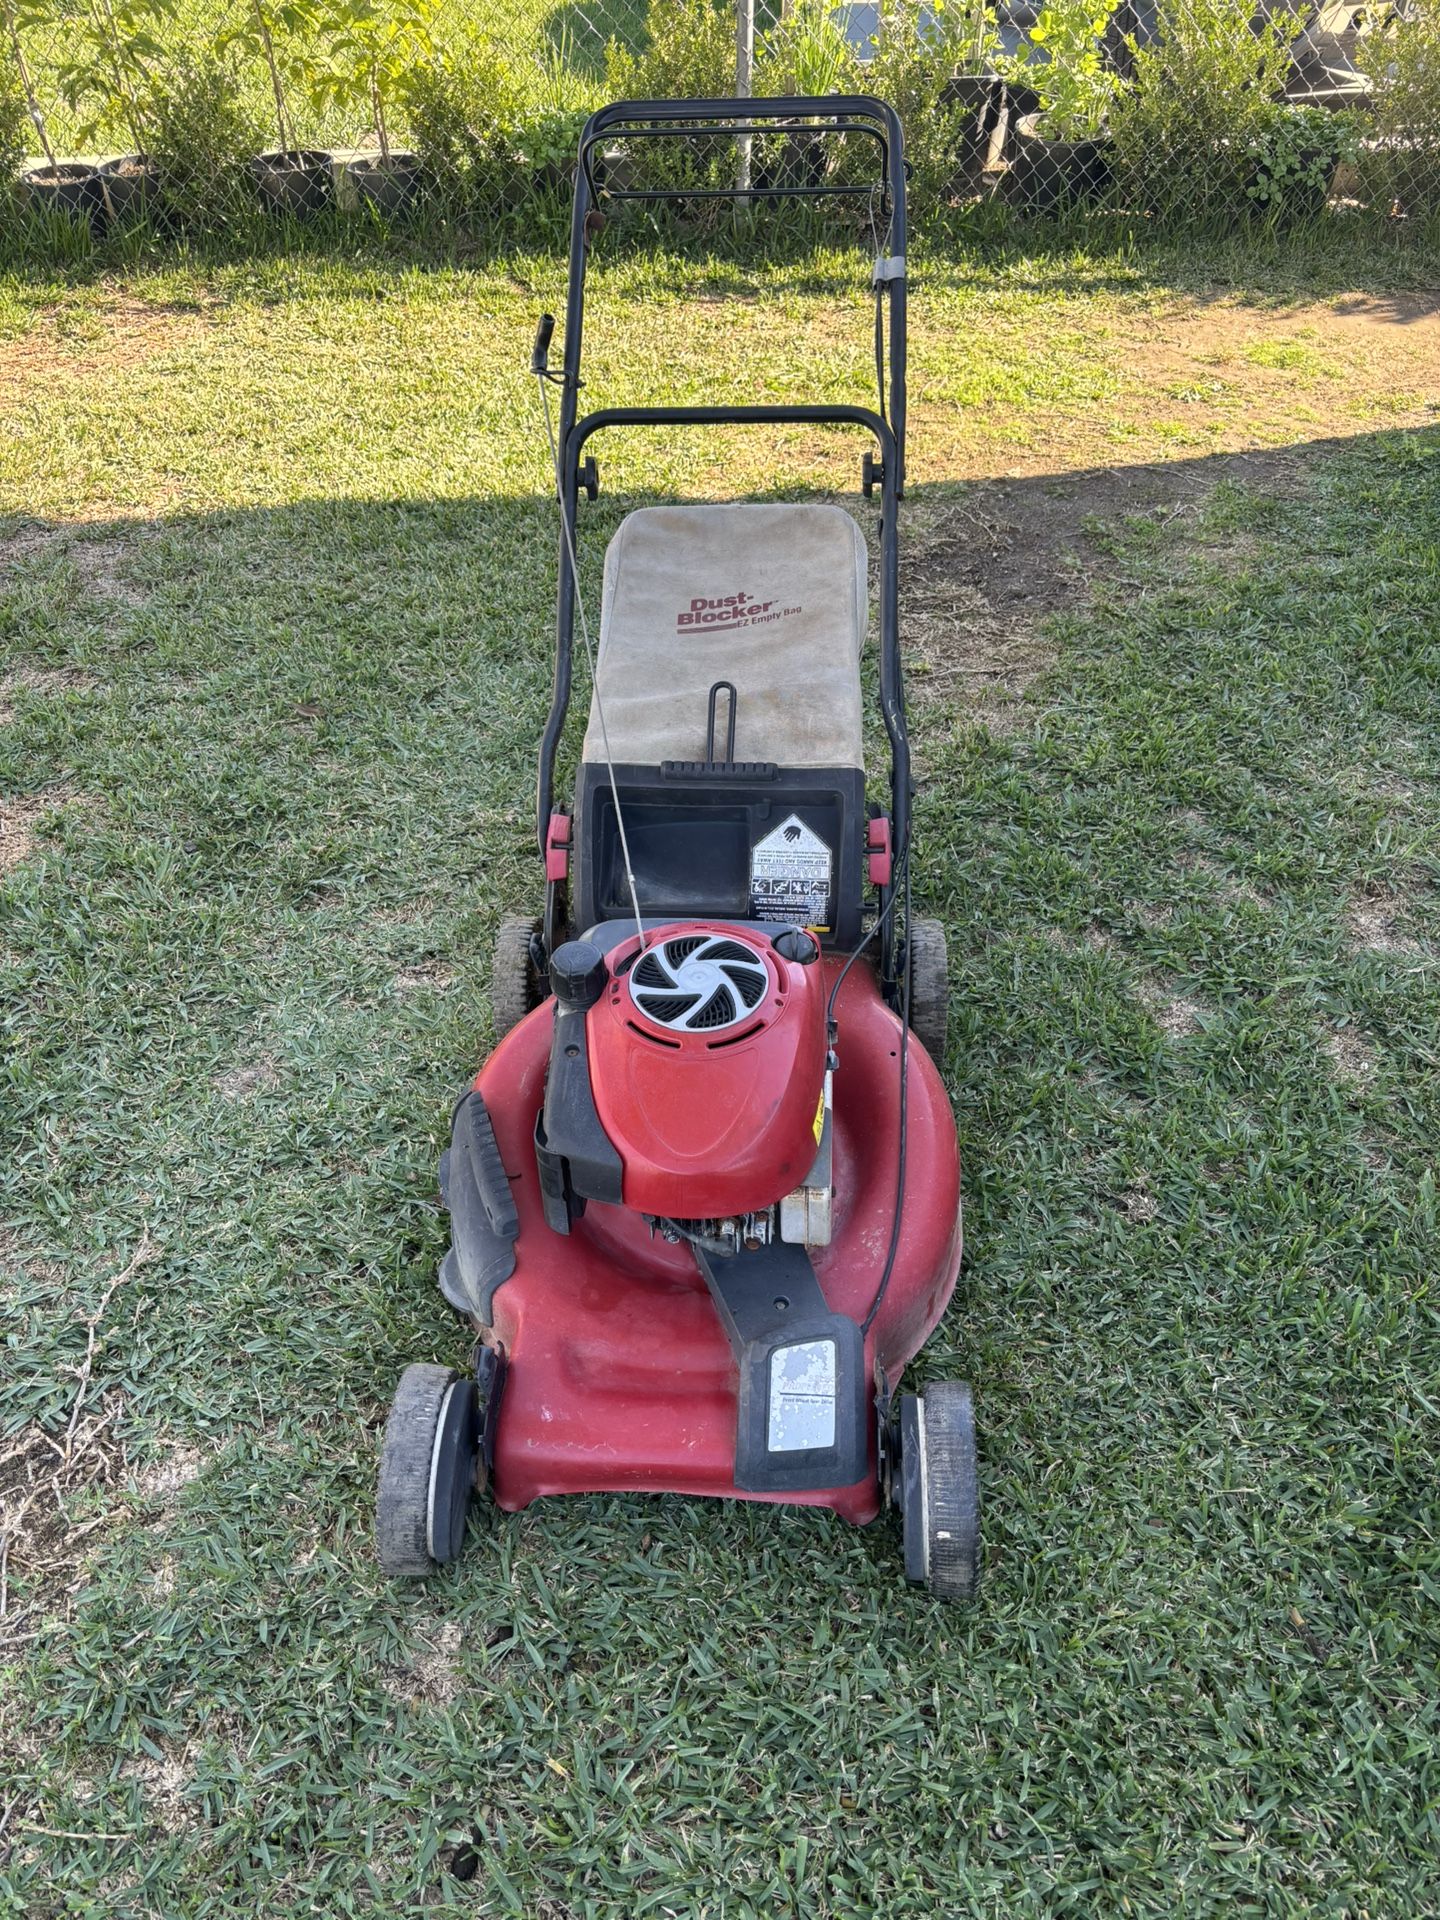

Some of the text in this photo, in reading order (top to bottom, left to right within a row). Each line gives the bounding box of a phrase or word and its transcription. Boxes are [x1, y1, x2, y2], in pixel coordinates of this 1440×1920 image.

[690, 592, 754, 611] Dust-
[737, 606, 802, 628] EZ Empty Bag
[761, 865, 822, 877] DANGER
